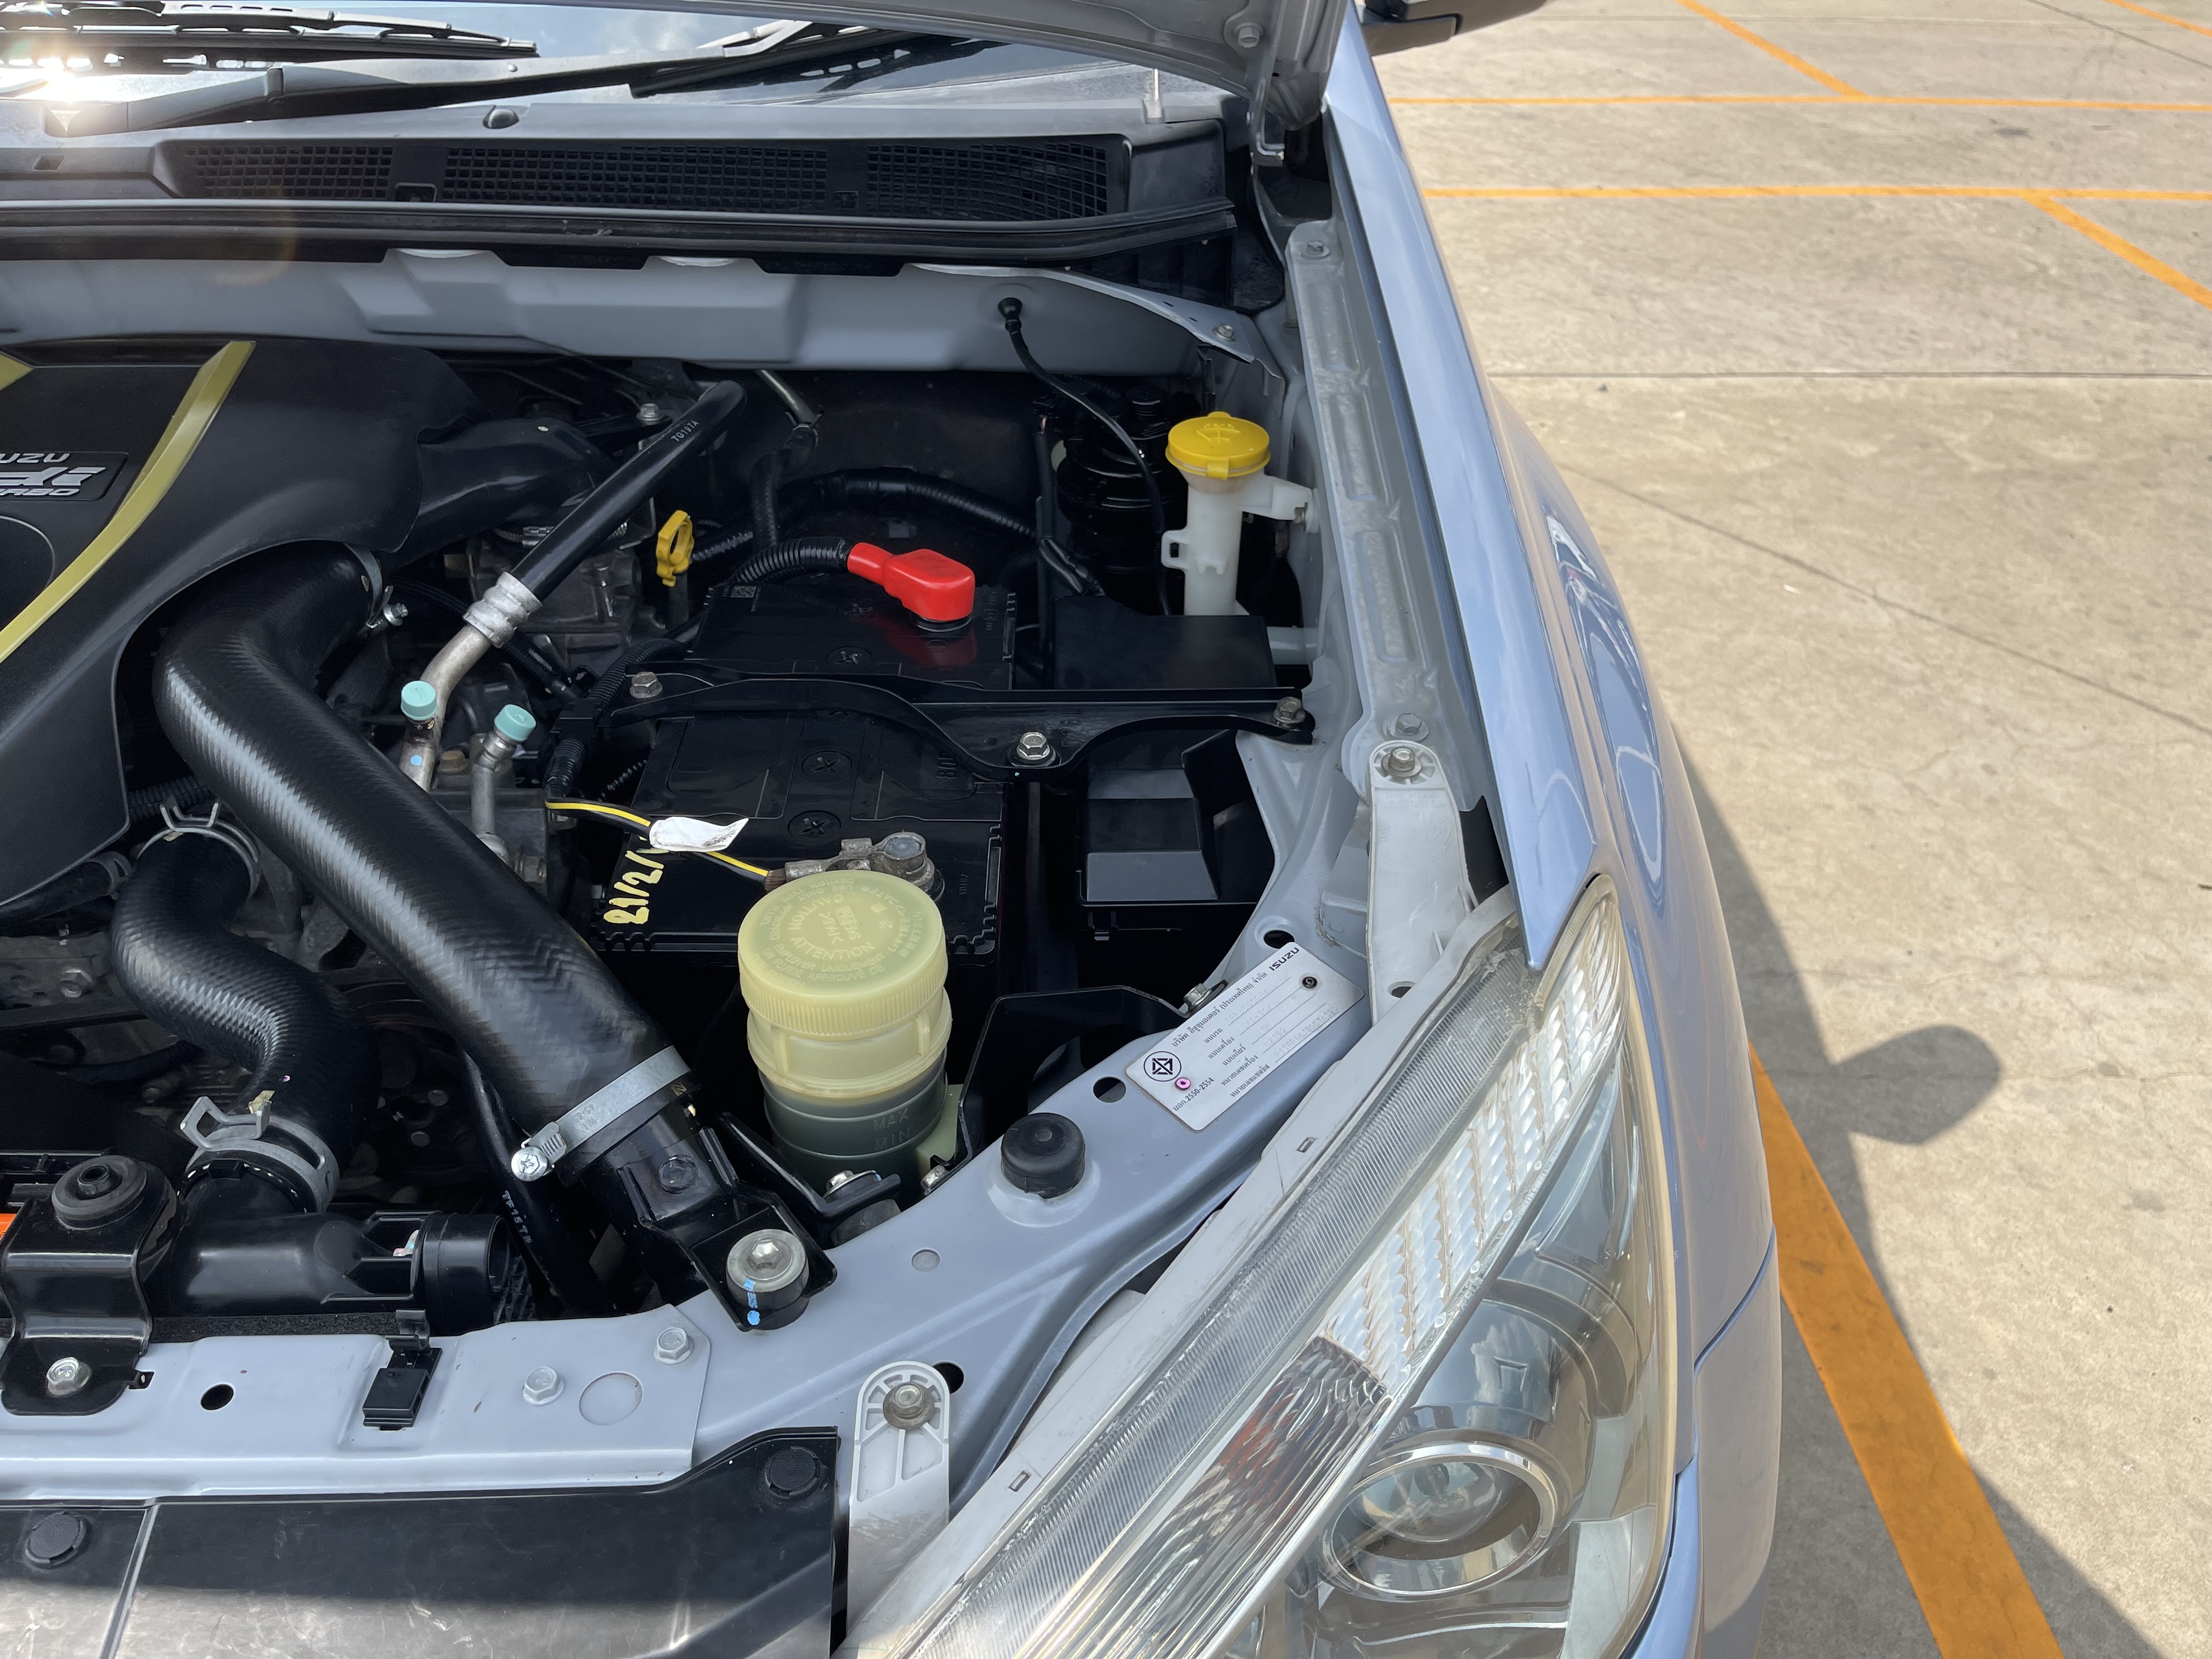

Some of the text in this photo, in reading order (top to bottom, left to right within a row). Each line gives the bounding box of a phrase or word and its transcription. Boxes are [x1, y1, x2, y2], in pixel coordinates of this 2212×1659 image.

[787, 894, 844, 930] CAUTION
[773, 943, 816, 970] EMPLOYER
[790, 936, 876, 960] ATTENTION
[1269, 947, 1300, 972] ISUZU
[762, 947, 775, 959] UN
[776, 958, 805, 978] FLUIDE
[868, 963, 885, 975] DE
[1172, 1030, 1189, 1047] บริษัท
[1220, 982, 1255, 1011] (ประเทศไทย)
[1252, 972, 1268, 987] จำกัด
[1204, 1027, 1223, 1044] แบบรถ
[1208, 1036, 1235, 1059] แบบเครื่อง
[1222, 1043, 1246, 1066] แบบเกียร์
[1221, 1054, 1259, 1086] หมายเลขเครื่อง
[1173, 1077, 1215, 1111] มอก.2550-2554
